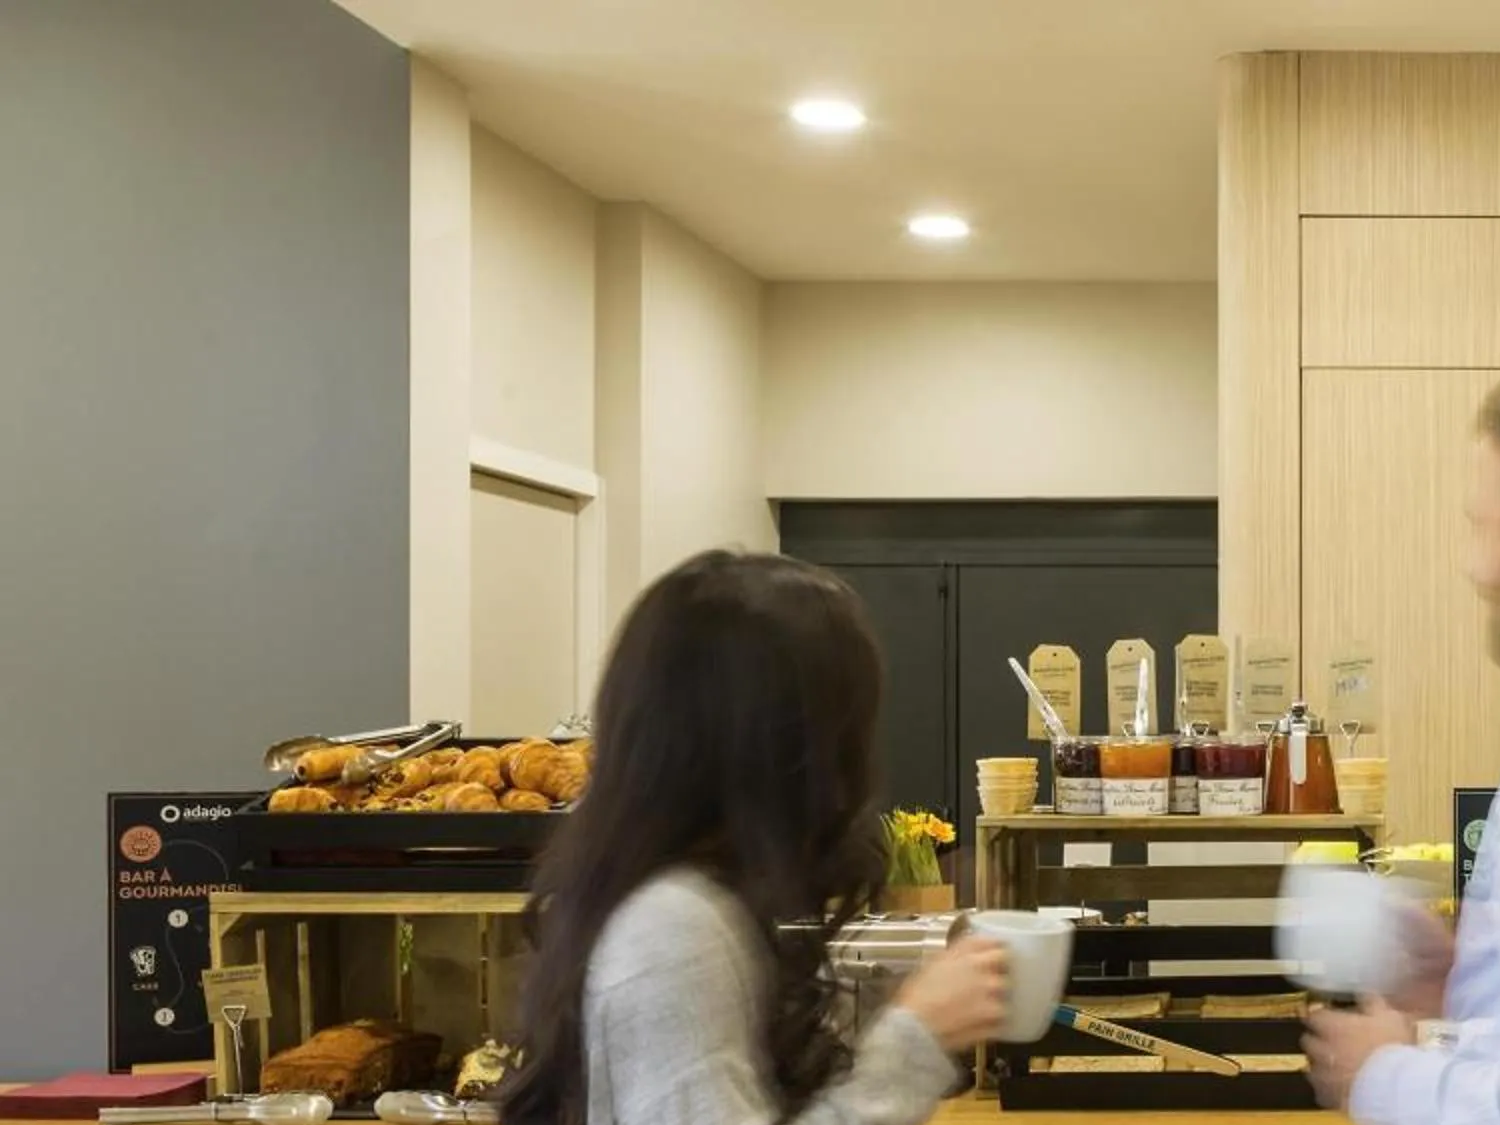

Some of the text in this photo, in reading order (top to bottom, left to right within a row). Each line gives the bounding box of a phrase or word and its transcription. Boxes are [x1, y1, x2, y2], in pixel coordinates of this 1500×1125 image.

[183, 804, 231, 820] adagio
[120, 870, 155, 882] BAR
[1088, 1021, 1115, 1037] PAIN
